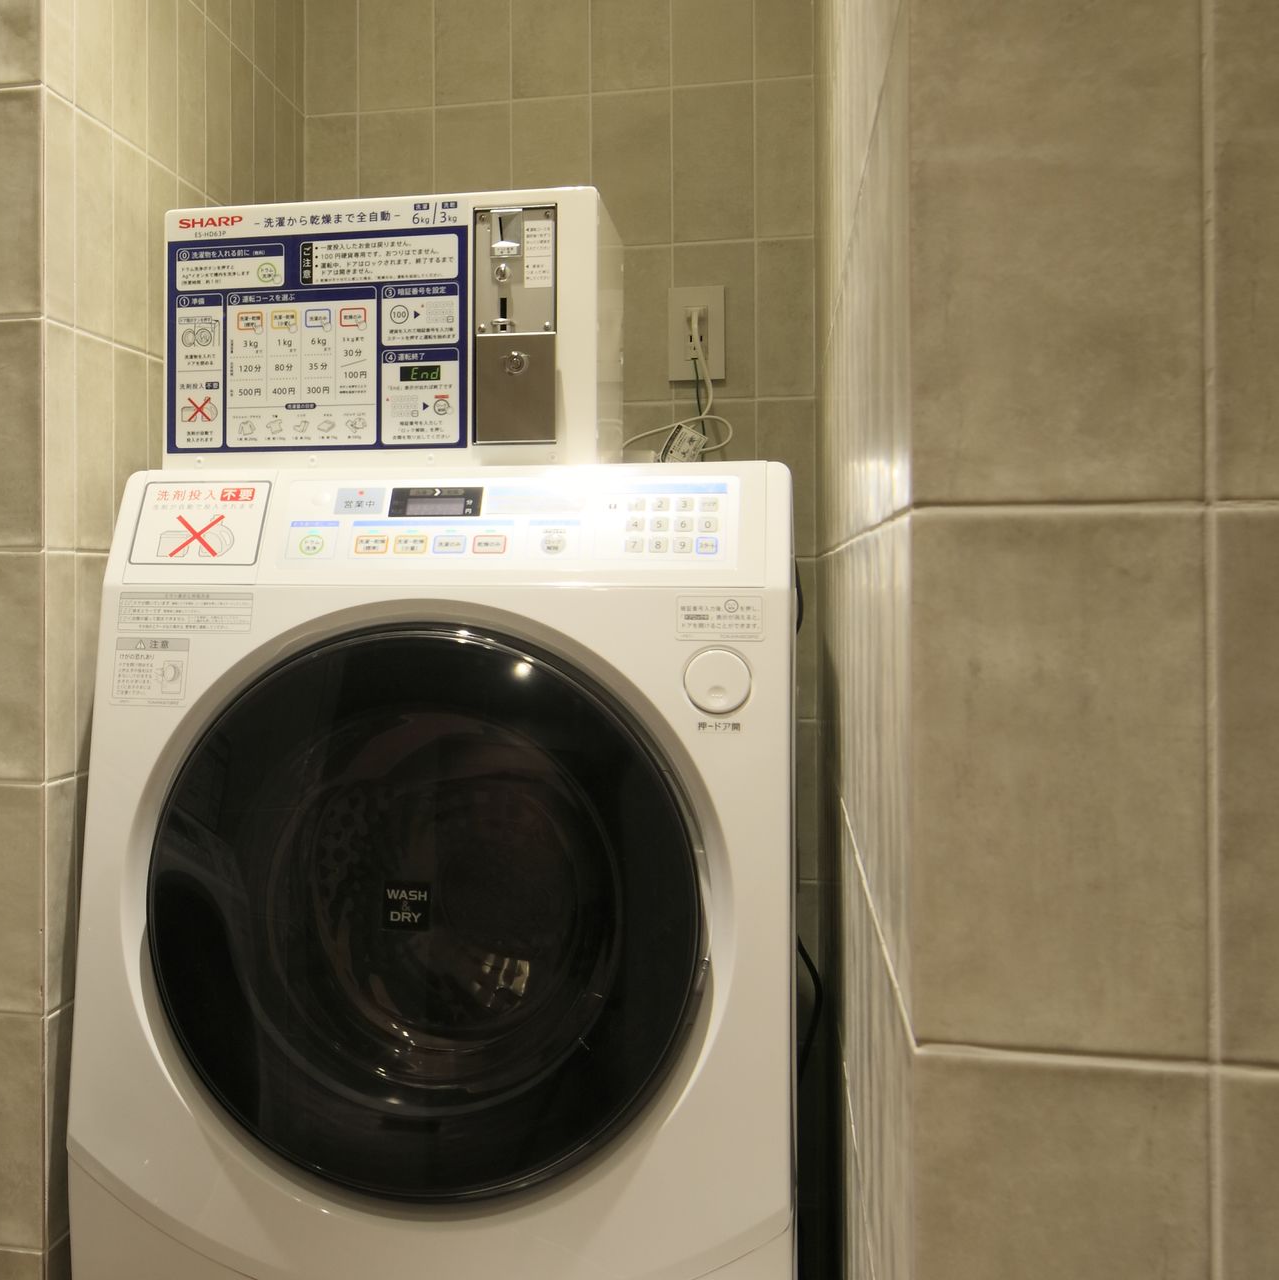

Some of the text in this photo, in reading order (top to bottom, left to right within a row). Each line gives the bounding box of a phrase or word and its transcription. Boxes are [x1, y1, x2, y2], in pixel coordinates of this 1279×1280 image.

[179, 215, 243, 229] SHARP
[411, 367, 439, 380] End
[156, 488, 254, 502] 洗剤投入 不要
[343, 500, 376, 509] 営業中
[386, 888, 428, 902] WASH
[389, 911, 422, 923] DRY
